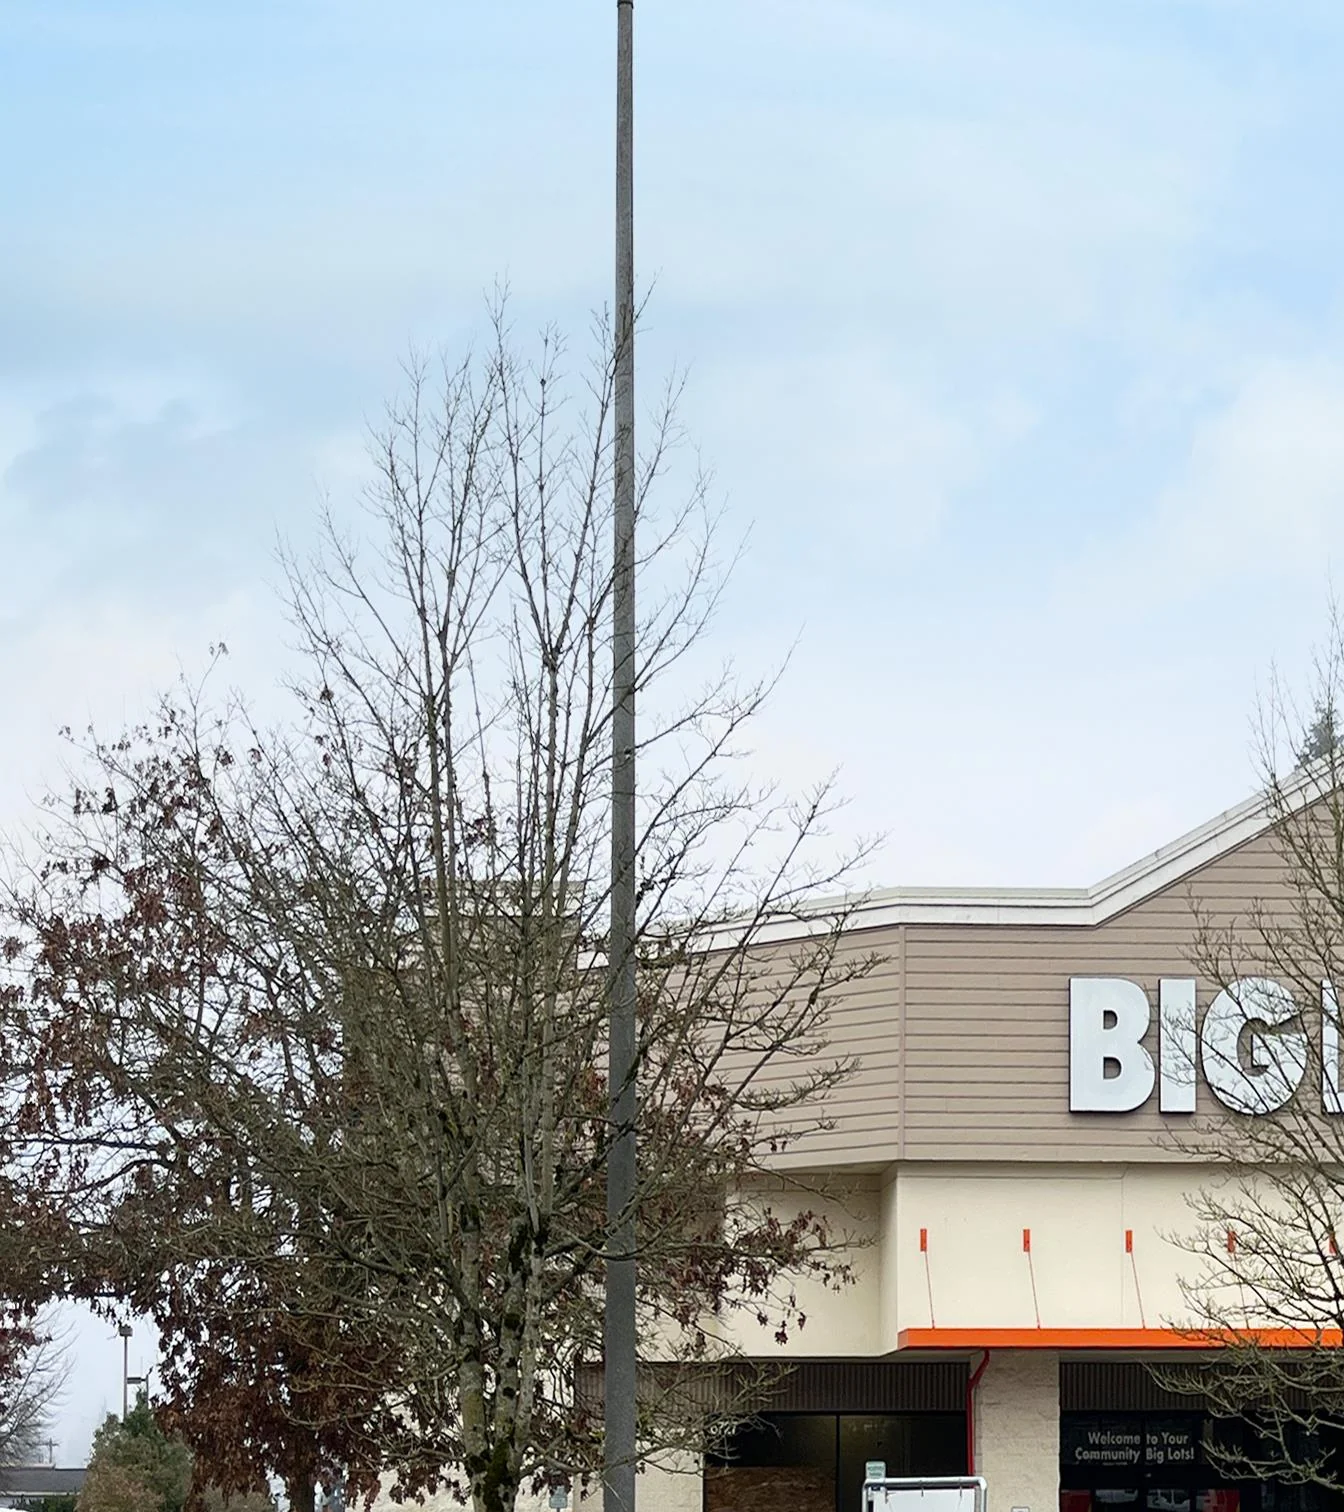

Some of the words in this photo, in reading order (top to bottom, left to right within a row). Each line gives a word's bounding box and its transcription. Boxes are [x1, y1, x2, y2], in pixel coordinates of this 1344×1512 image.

[1068, 975, 1307, 1116] BIG
[1087, 1431, 1141, 1445] Welcome
[1146, 1432, 1159, 1445] to
[1161, 1431, 1189, 1445] Your
[1075, 1446, 1141, 1464] Community
[1145, 1446, 1165, 1464] Big
[1168, 1446, 1195, 1461] Lots!
